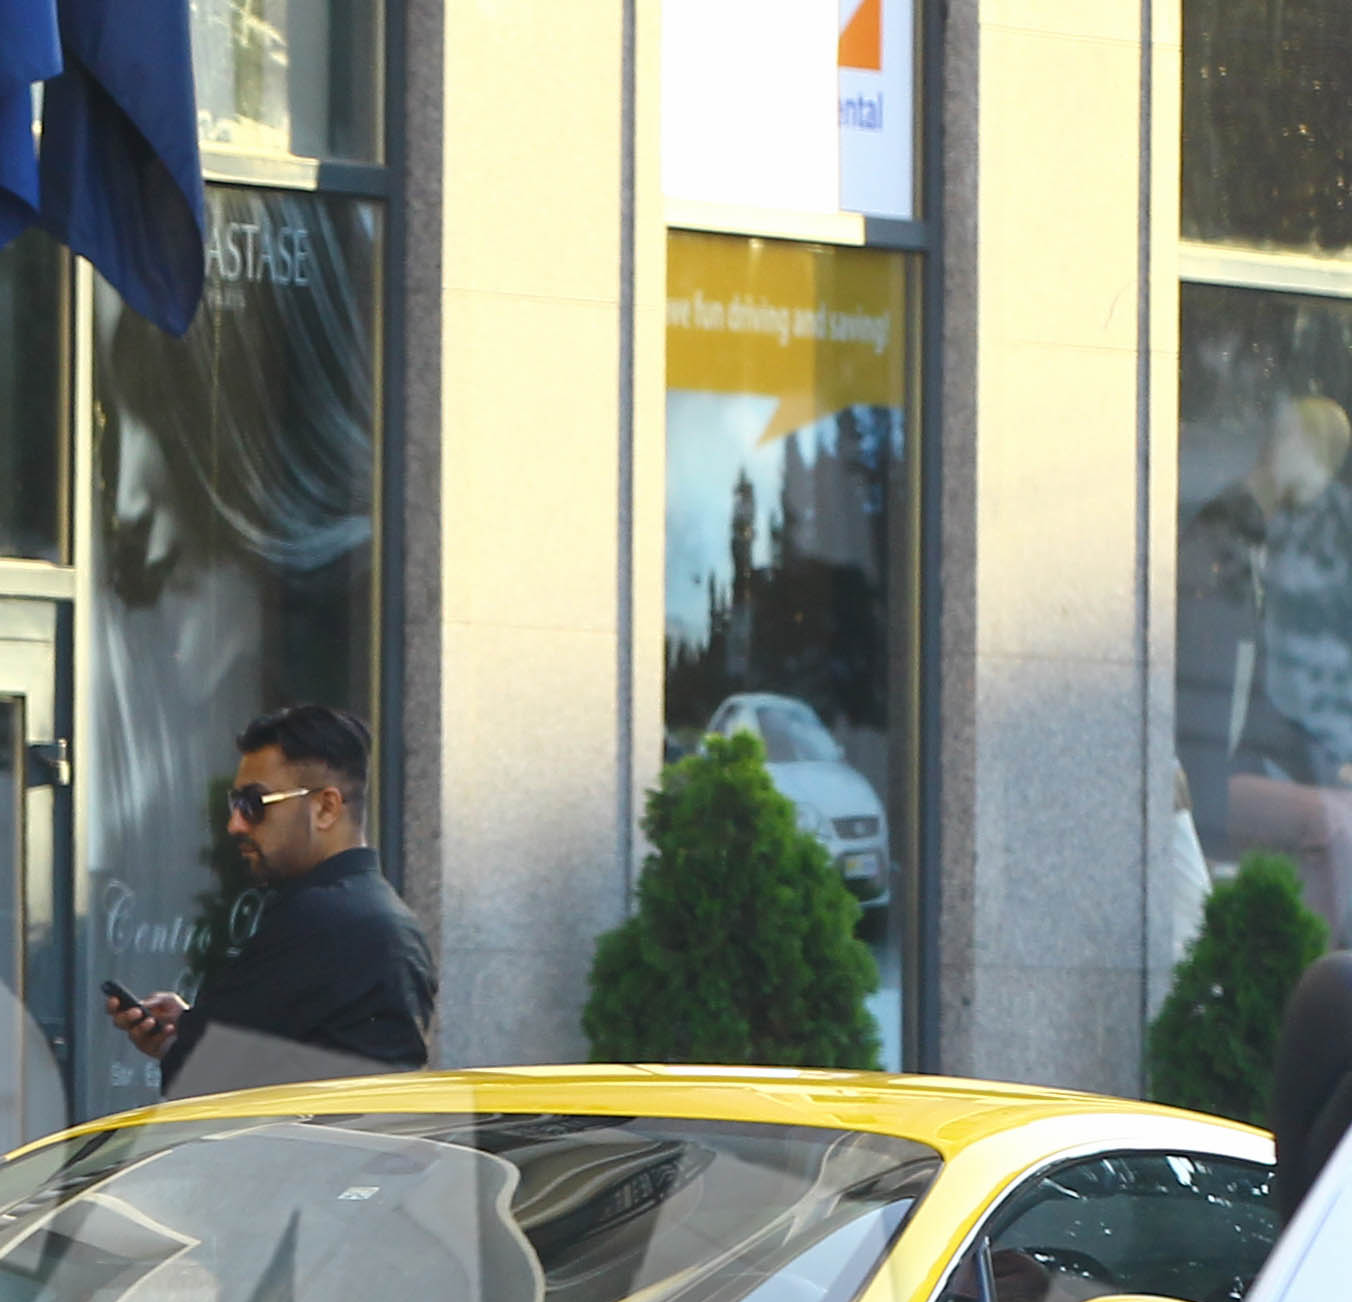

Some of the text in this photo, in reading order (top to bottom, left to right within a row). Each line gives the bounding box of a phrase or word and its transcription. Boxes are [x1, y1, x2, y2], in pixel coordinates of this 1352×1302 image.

[693, 289, 724, 331] fun
[728, 292, 790, 348] driving
[793, 300, 827, 340] and
